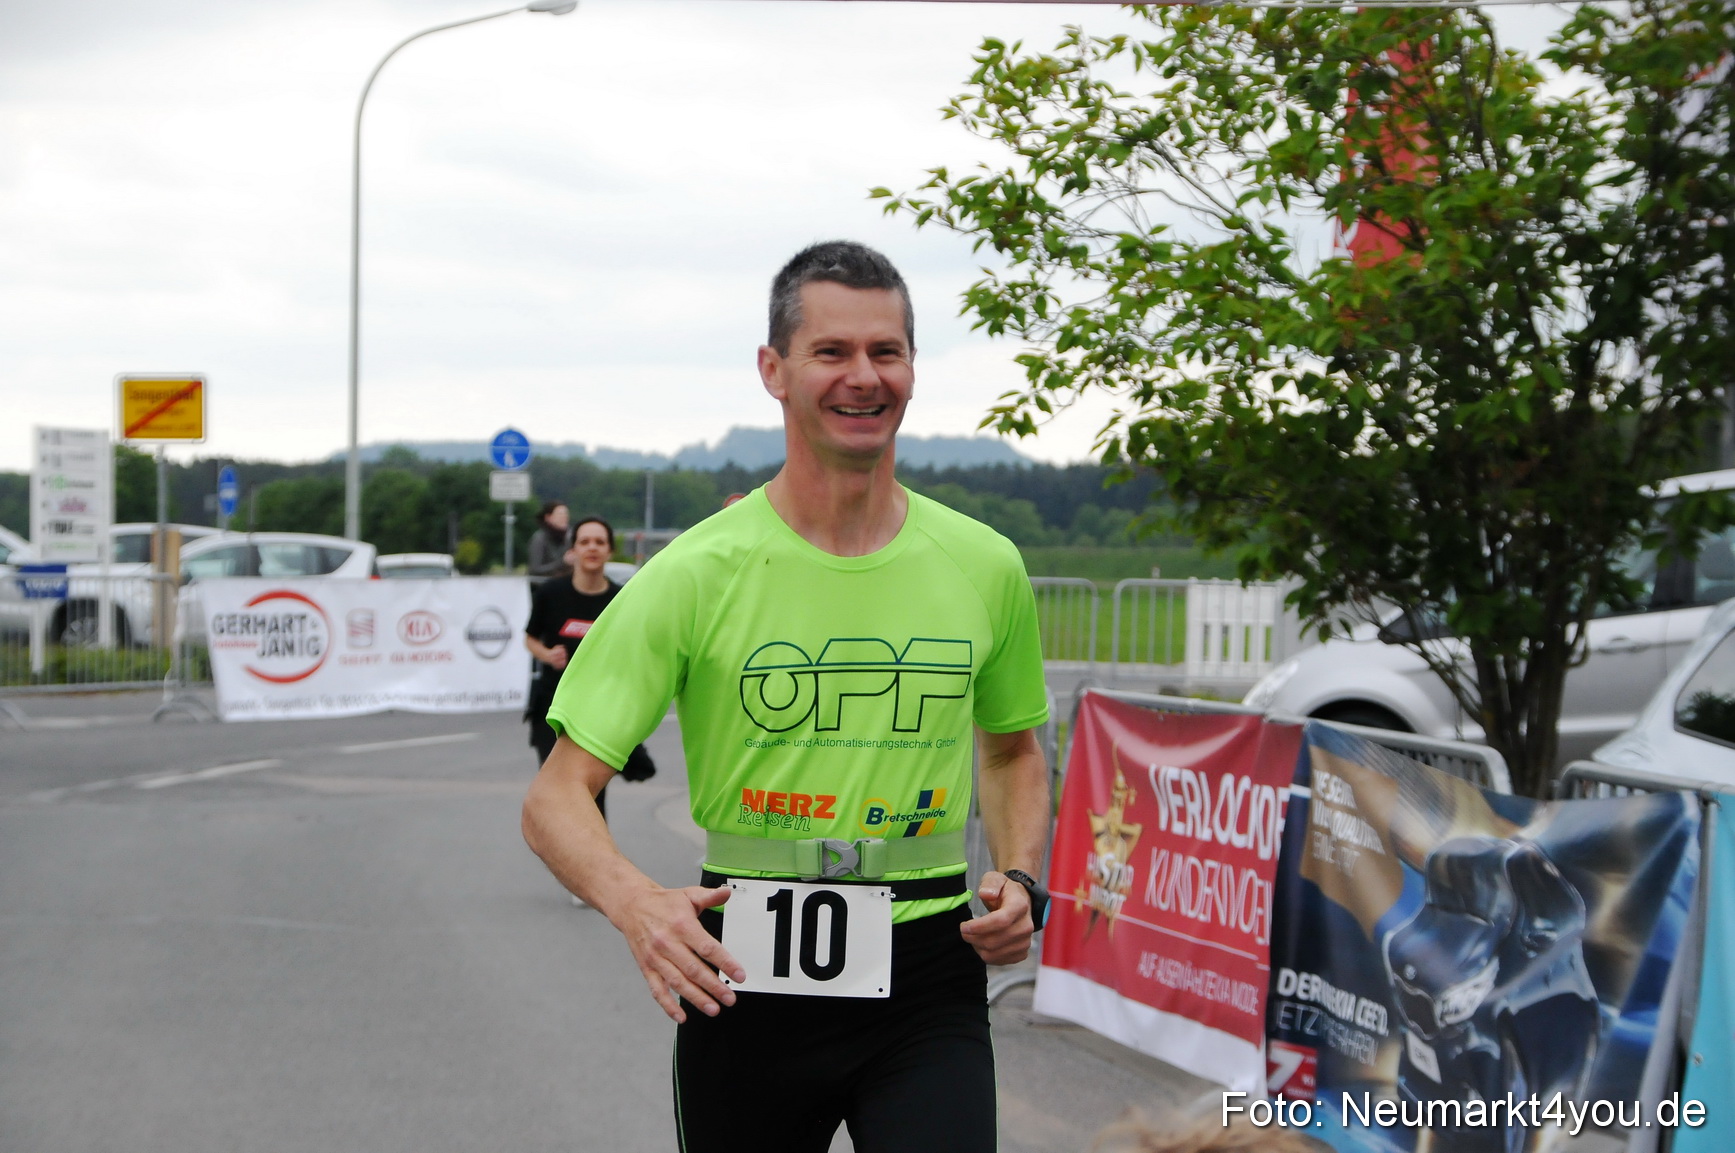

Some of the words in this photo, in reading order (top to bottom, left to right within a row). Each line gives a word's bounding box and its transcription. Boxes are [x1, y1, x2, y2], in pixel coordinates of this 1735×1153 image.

[212, 613, 307, 635] GERHART
[740, 638, 972, 733] OPF
[793, 737, 812, 748] und
[813, 737, 932, 750] Automatisierungstechnik
[935, 736, 957, 749] GmbH
[737, 803, 811, 832] Reisen
[742, 788, 837, 819] MERZ
[766, 888, 848, 982] 10
[1267, 1047, 1306, 1092] 7
